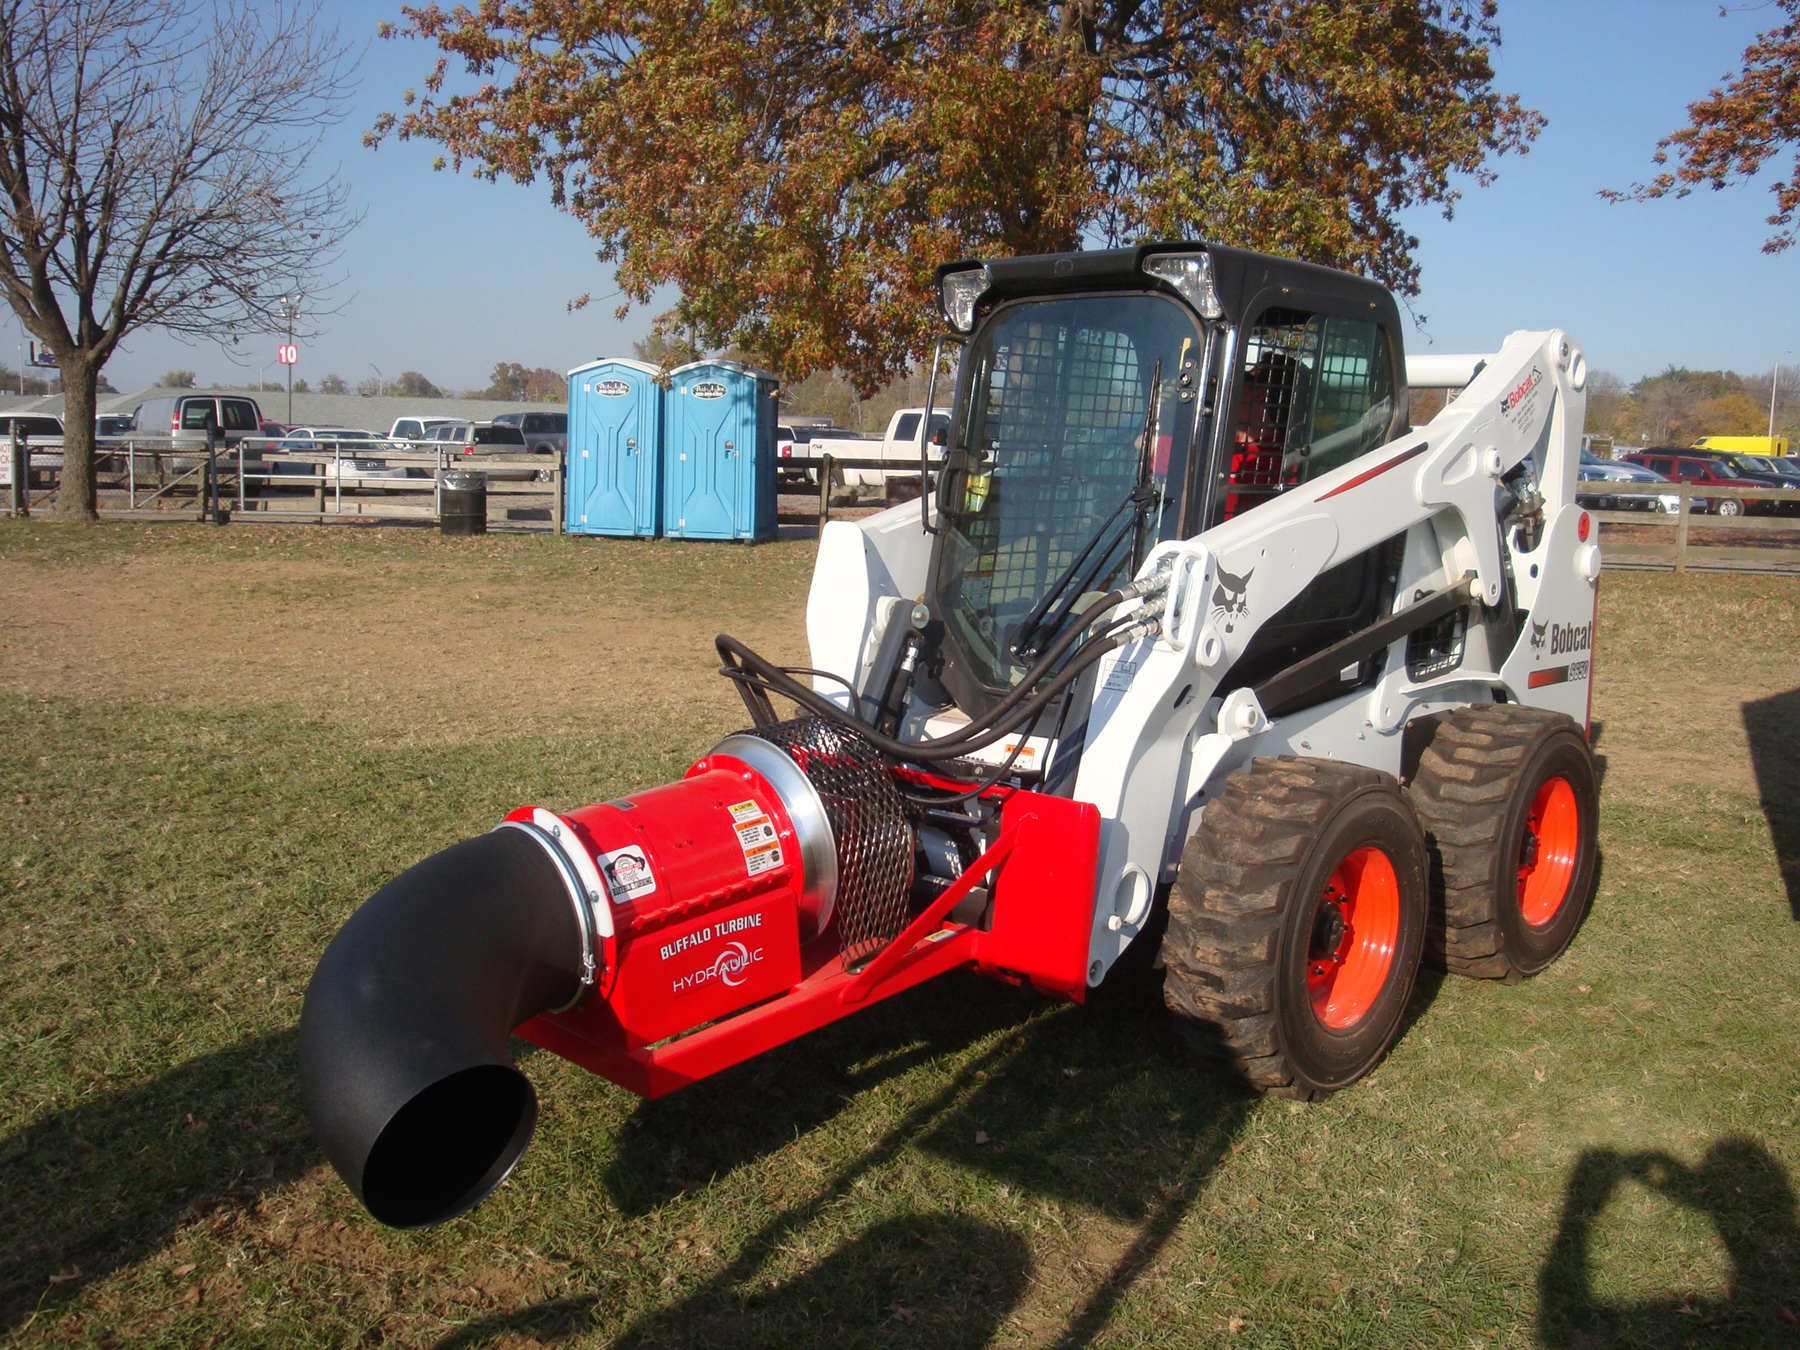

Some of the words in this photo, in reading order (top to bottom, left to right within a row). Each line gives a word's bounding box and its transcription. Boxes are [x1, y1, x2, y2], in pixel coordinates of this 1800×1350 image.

[280, 346, 297, 363] 10
[1508, 373, 1533, 409] Bobcat
[1550, 621, 1592, 655] Bobcat
[660, 927, 711, 960] BUFFALO
[714, 913, 762, 937] TURBINE
[673, 948, 764, 992] HYDRAULIC
